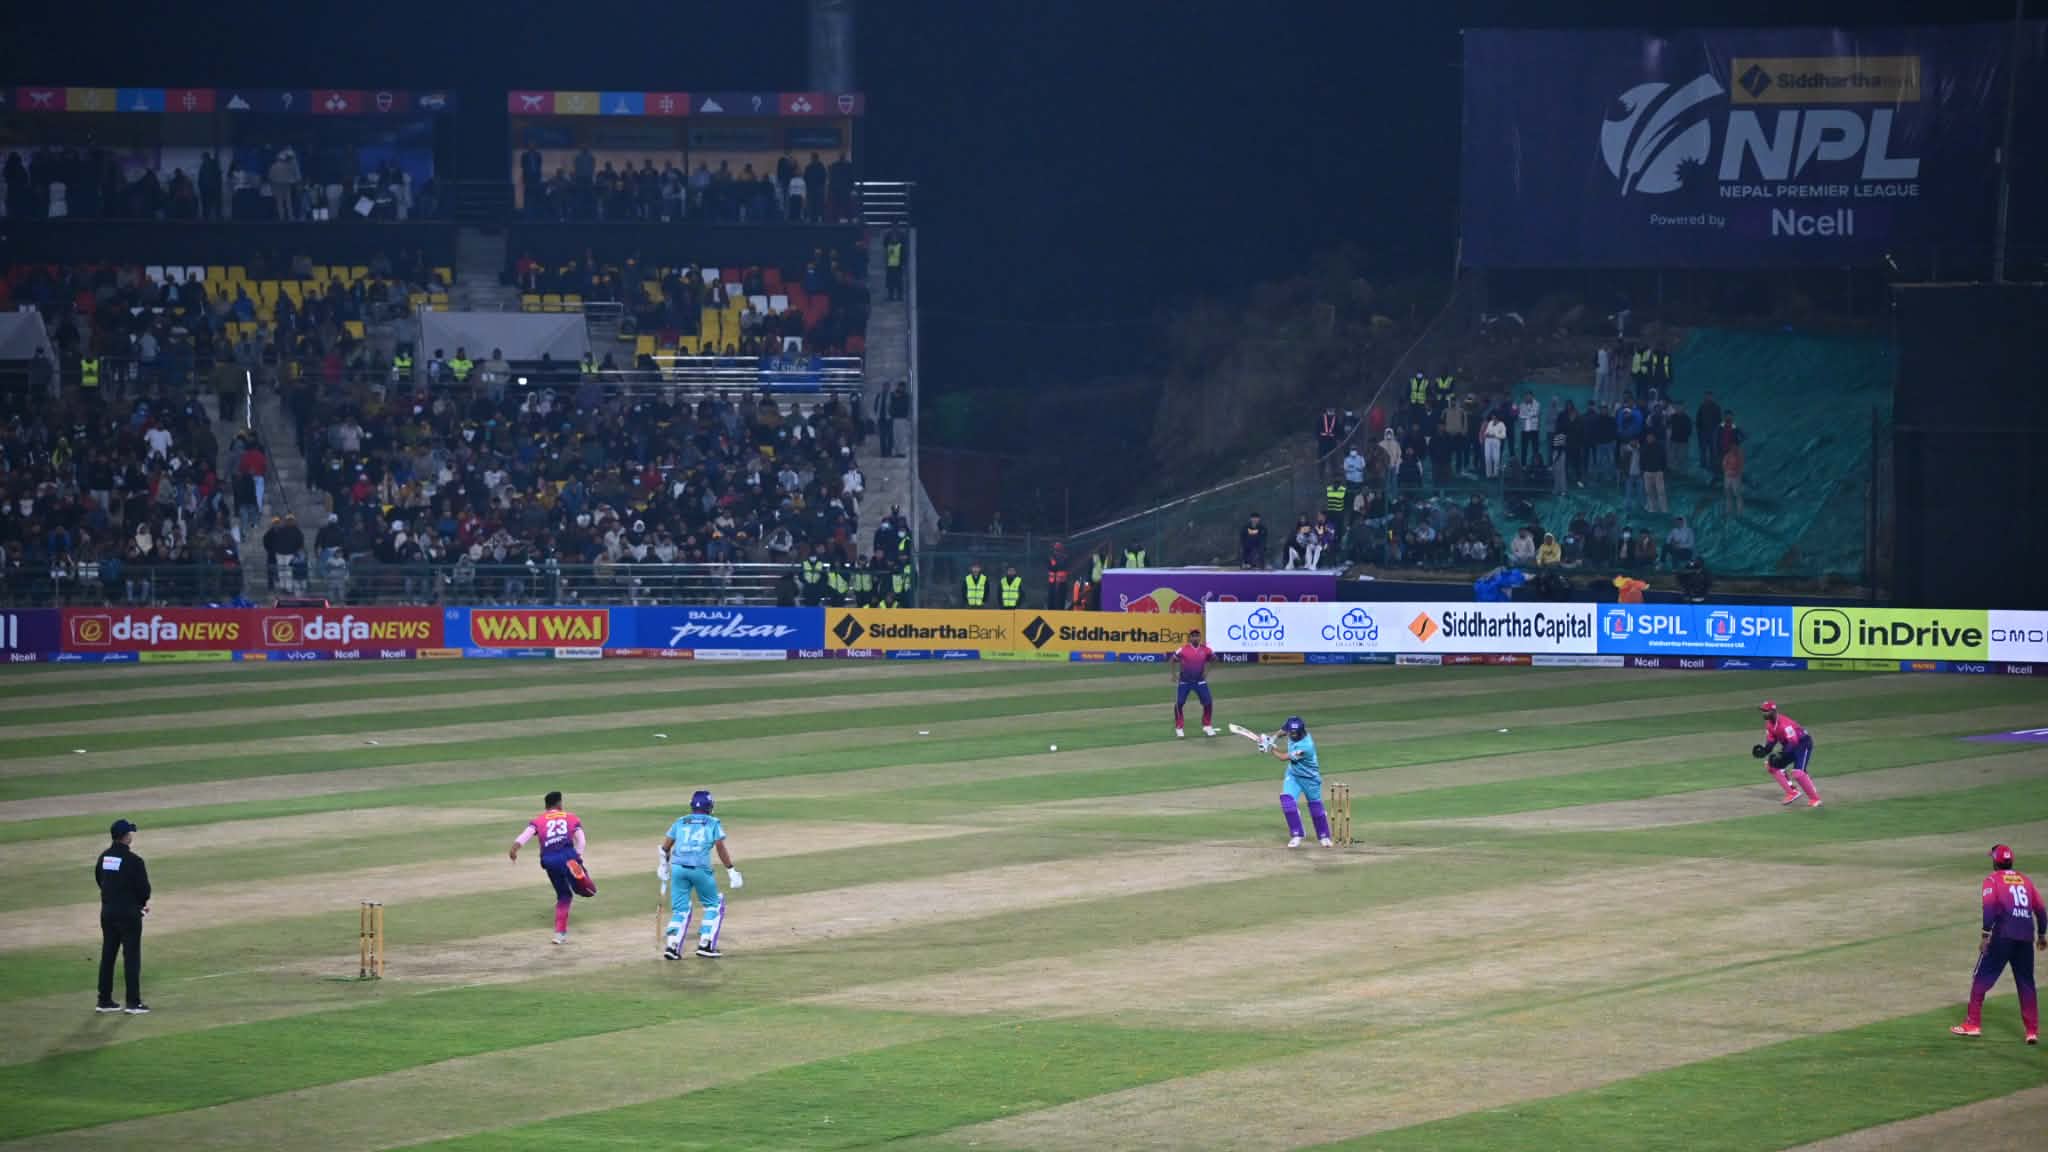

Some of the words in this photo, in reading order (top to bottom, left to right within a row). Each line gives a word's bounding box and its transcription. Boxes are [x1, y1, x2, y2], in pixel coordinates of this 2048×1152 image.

[1718, 109, 1920, 180] NPL
[1720, 184, 1773, 198] NEPAL
[1776, 184, 1848, 198] PREMIER
[1854, 183, 1920, 197] LEAGUE
[1650, 213, 1705, 226] Powered
[1709, 213, 1725, 228] by
[1771, 208, 1853, 236] Ncell
[688, 611, 731, 620] BAJAJ
[1638, 615, 1688, 635] SPIL
[476, 616, 536, 640] WAI
[542, 616, 602, 640] WAI
[669, 613, 798, 647] pulsar
[1059, 626, 1196, 643] SiddharthaBan
[1227, 625, 1284, 641] Cloud
[1321, 625, 1378, 641] Cloud
[1442, 611, 1531, 637] Siddhartha
[1534, 612, 1592, 644] Capital
[1741, 617, 1789, 637] SPIL
[1859, 619, 1983, 647] inDrive
[1992, 629, 2048, 643] OMO
[546, 819, 568, 838] 23
[682, 826, 705, 845] 14
[2009, 885, 2028, 907] 16
